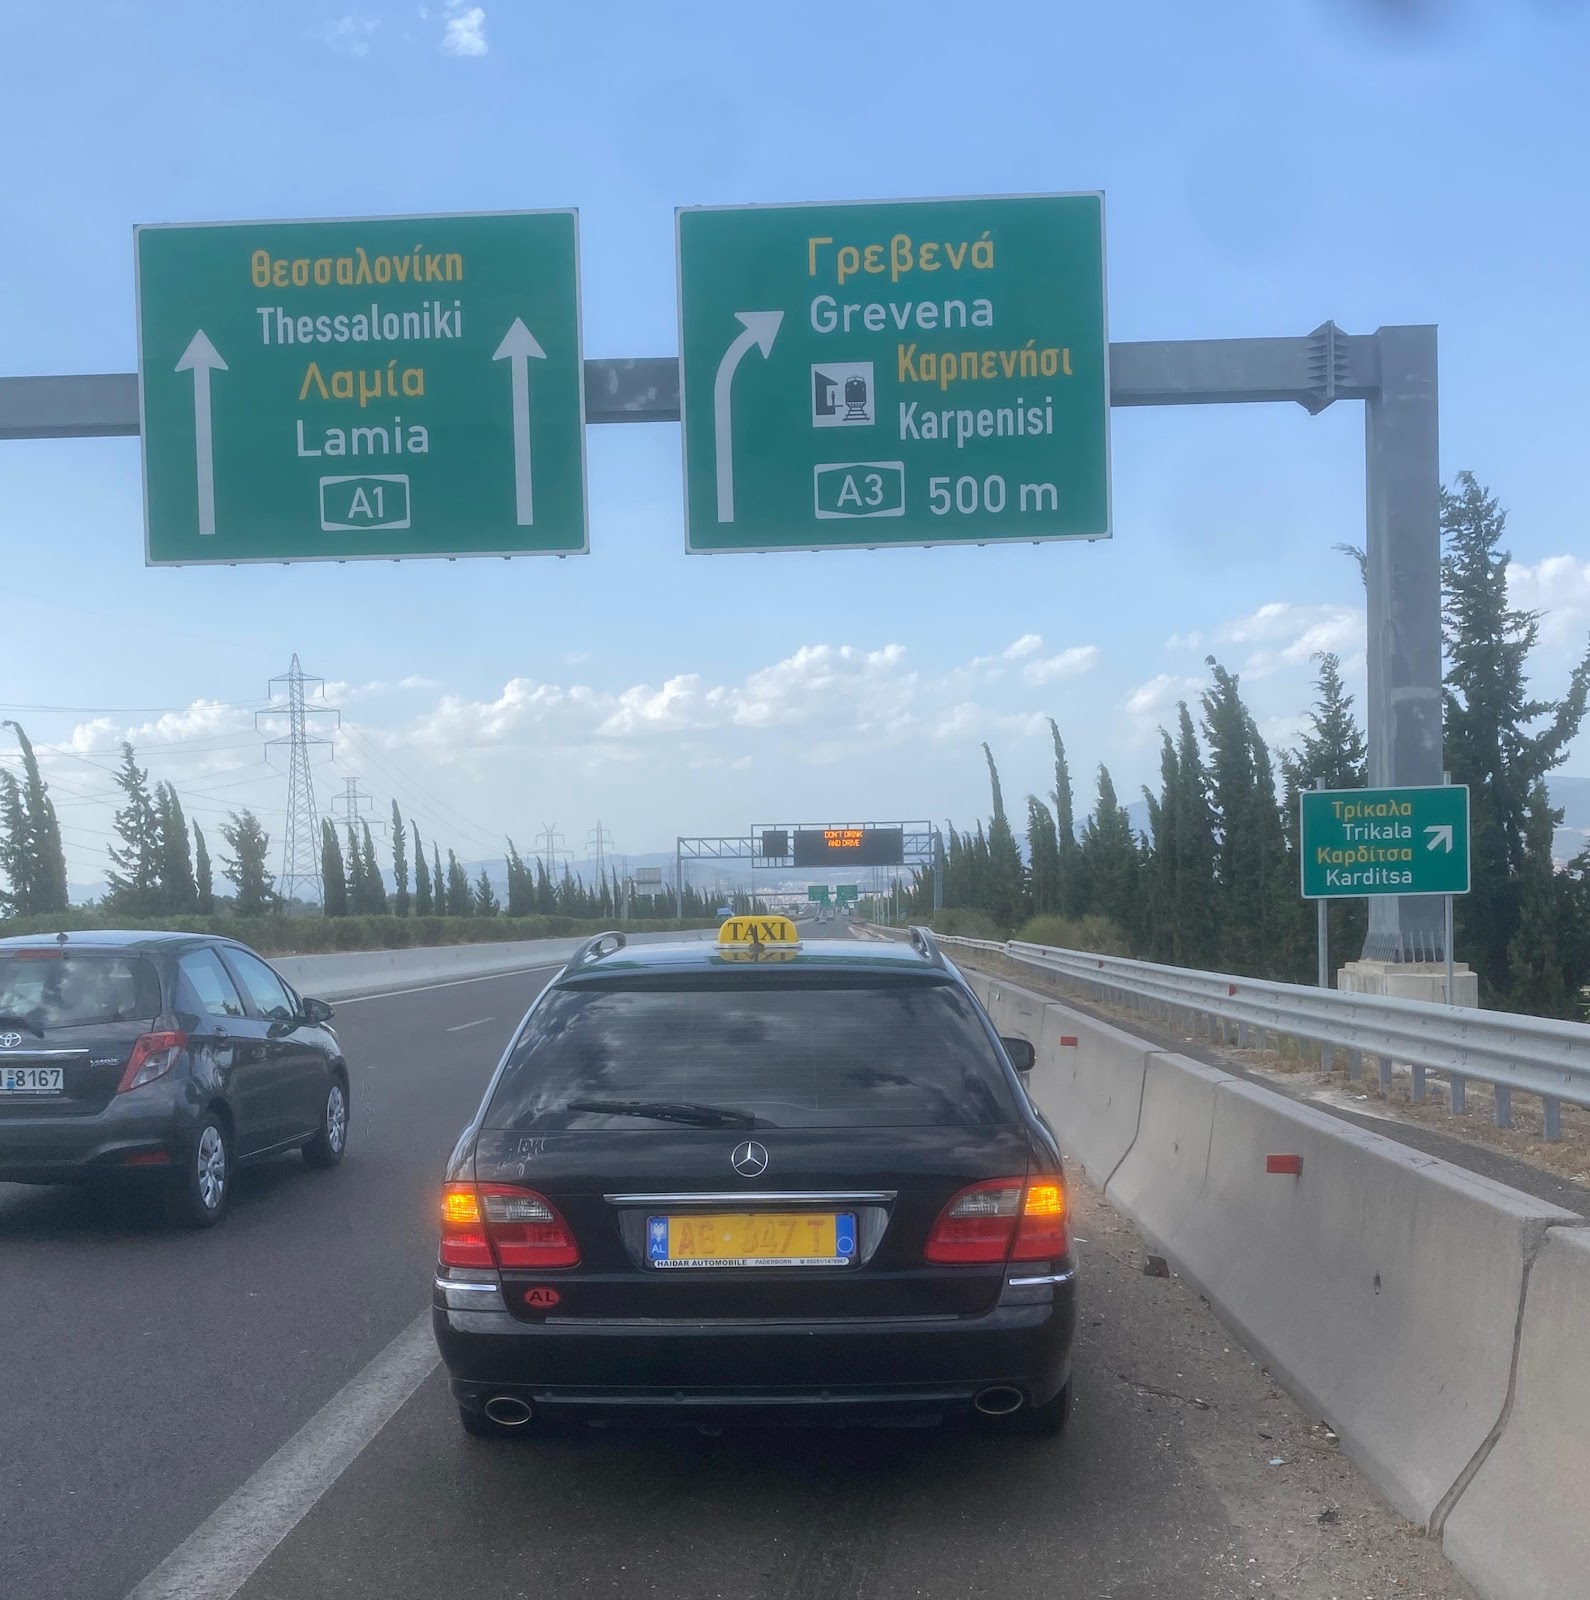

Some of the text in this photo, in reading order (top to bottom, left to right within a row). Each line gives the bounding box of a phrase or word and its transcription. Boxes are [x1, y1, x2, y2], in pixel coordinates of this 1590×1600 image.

[250, 244, 464, 288] Θεσσαλονίκη
[808, 230, 995, 285] Γρεβενά
[256, 300, 463, 345] Thessaloniki
[809, 294, 994, 334] Grevena
[897, 339, 1073, 391] Καρπενήσι
[298, 360, 425, 408] Λαμία
[296, 416, 430, 457] Lamia
[899, 396, 1054, 448] Karpenisi
[347, 486, 385, 518] A1
[836, 473, 884, 507] A3
[928, 474, 1059, 516] 500 m
[1331, 799, 1412, 822] Τρίκαλα
[828, 839, 860, 847] AND DRIVE
[844, 830, 863, 838] DRINK
[1342, 821, 1412, 841] Trikala
[1317, 845, 1413, 867] Καρδίτσα
[1326, 867, 1413, 887] Karditsa
[727, 922, 788, 941] TAXI
[651, 1244, 667, 1254] AL
[806, 1218, 826, 1253] T
[657, 1259, 690, 1267] HAIDAR
[692, 1258, 748, 1267] AUTOMOBILE
[530, 1291, 556, 1302] AL
